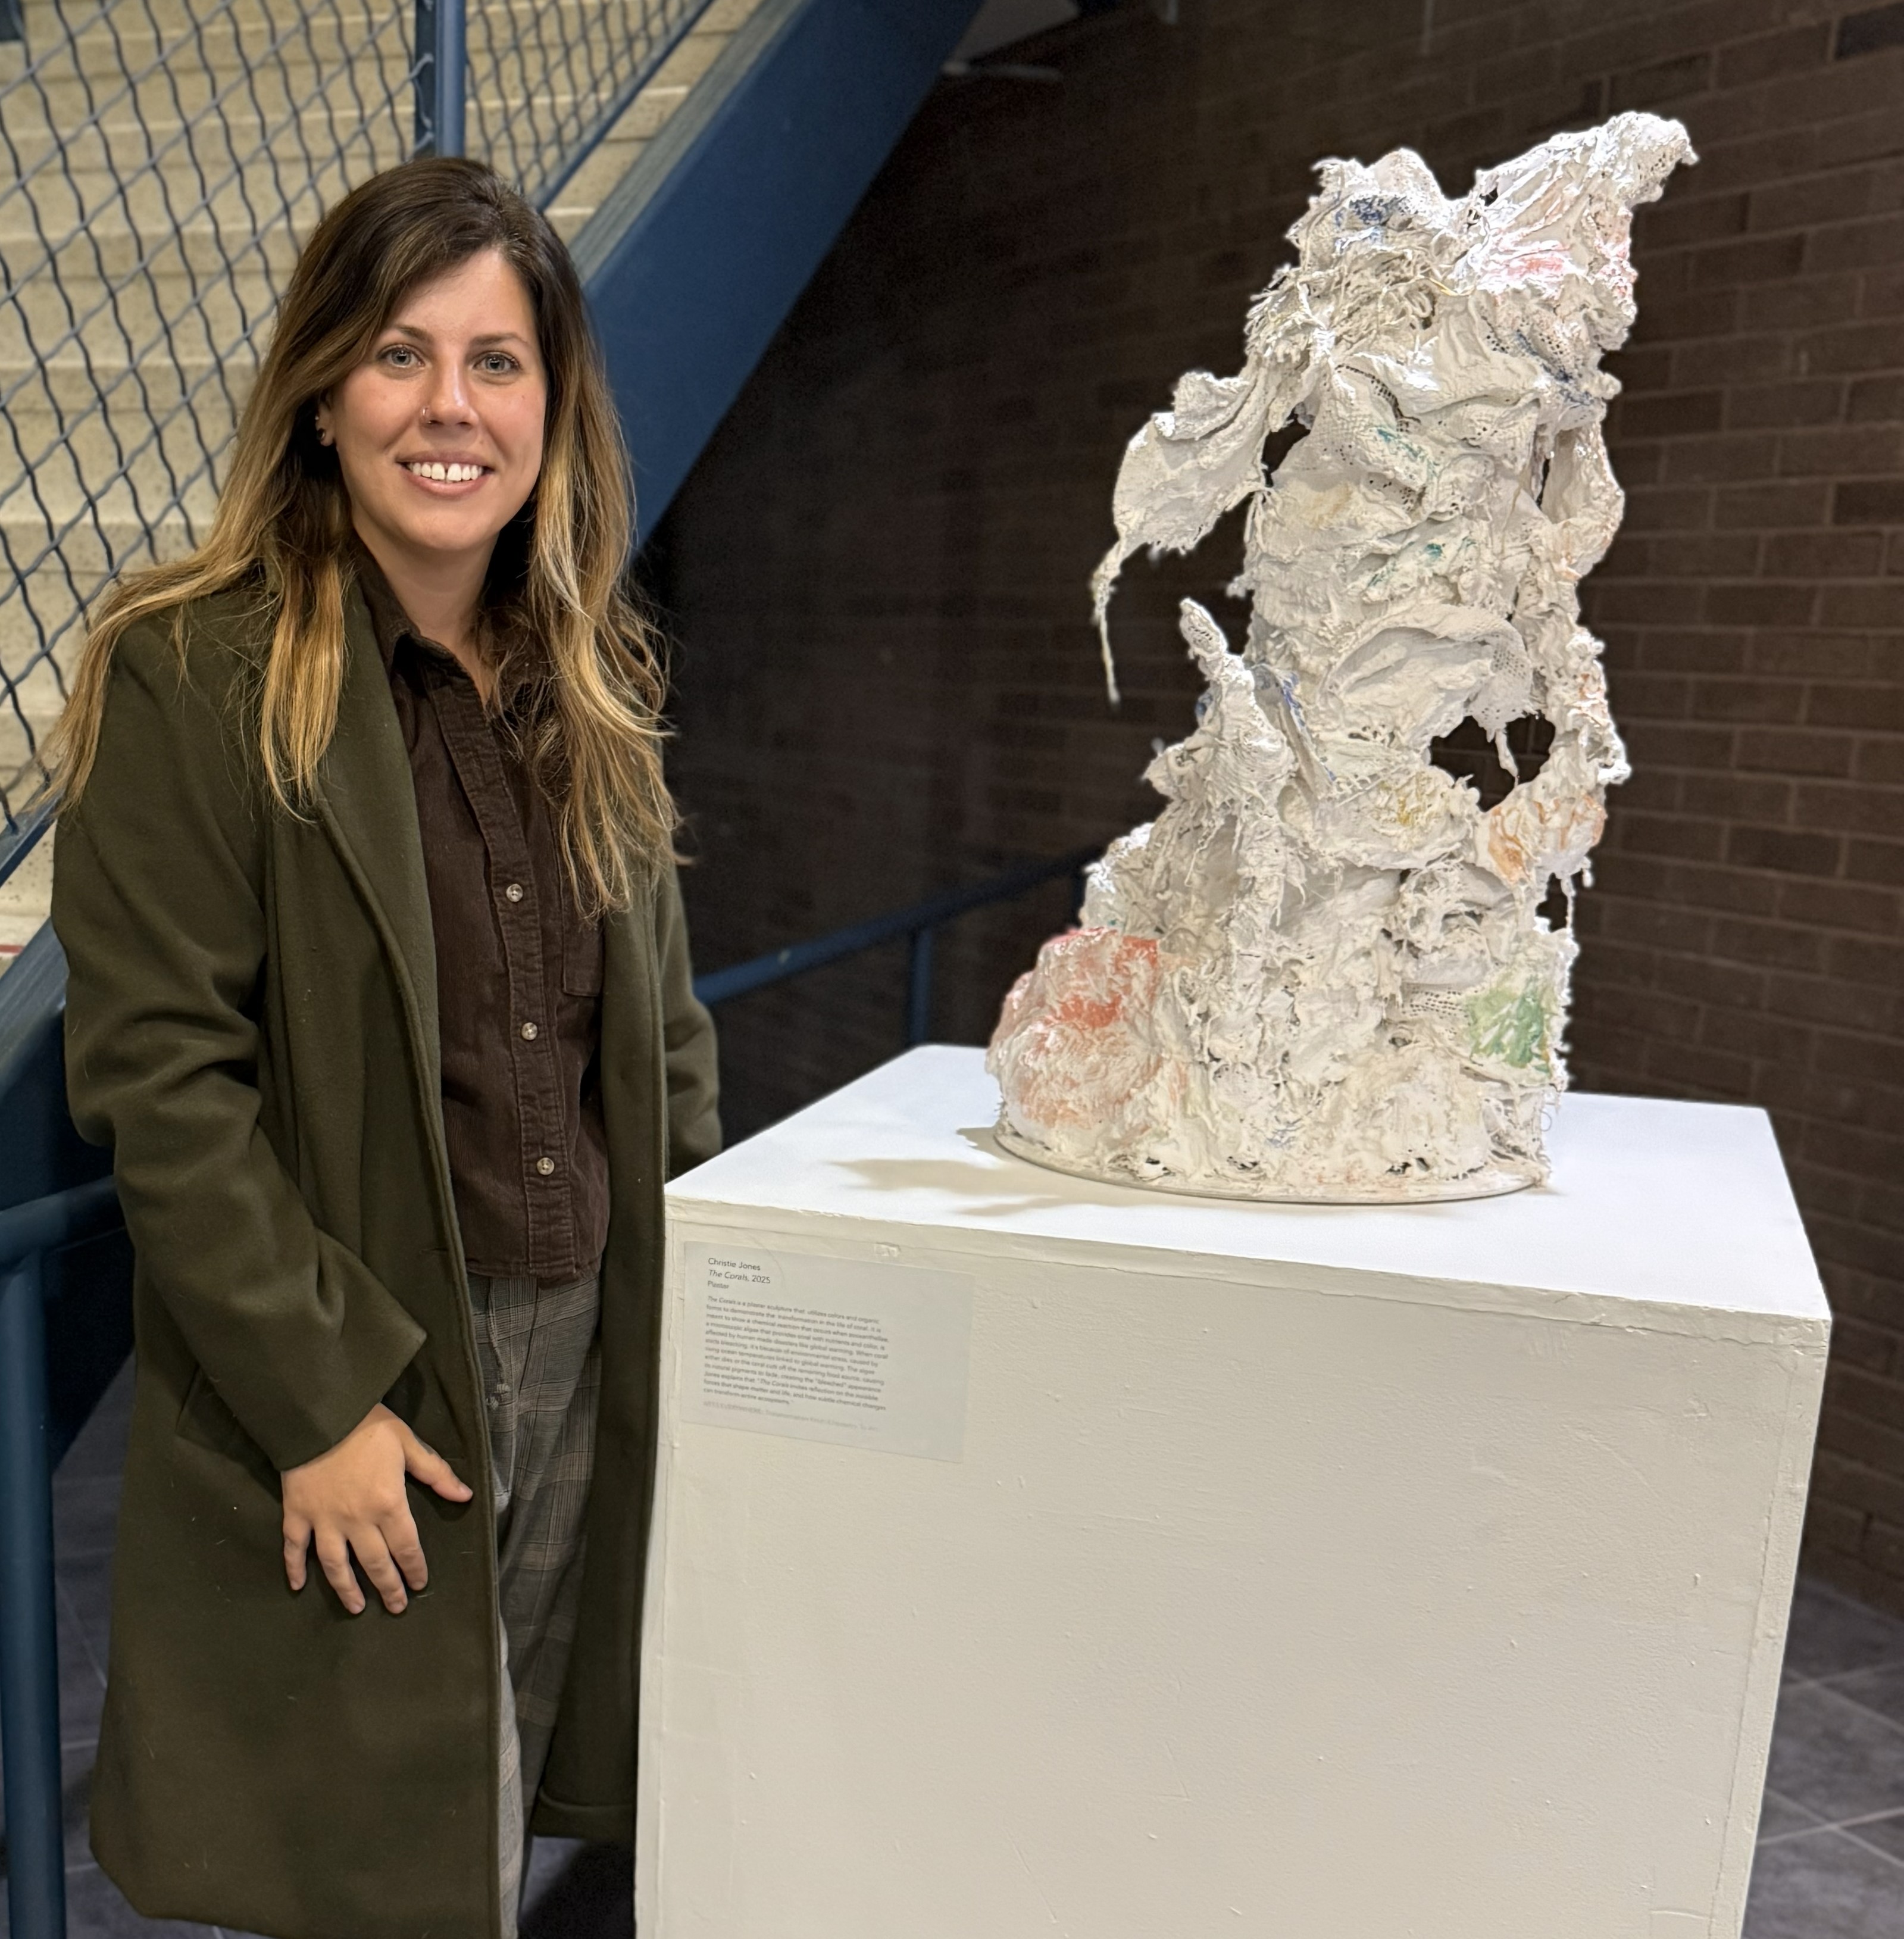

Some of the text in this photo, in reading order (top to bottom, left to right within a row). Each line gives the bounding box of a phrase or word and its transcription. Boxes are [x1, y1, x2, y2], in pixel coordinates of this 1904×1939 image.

[708, 1257, 760, 1270] Christie Jones
[709, 1269, 721, 1277] The
[752, 1275, 770, 1284] 2025
[708, 1280, 729, 1289] Plaster
